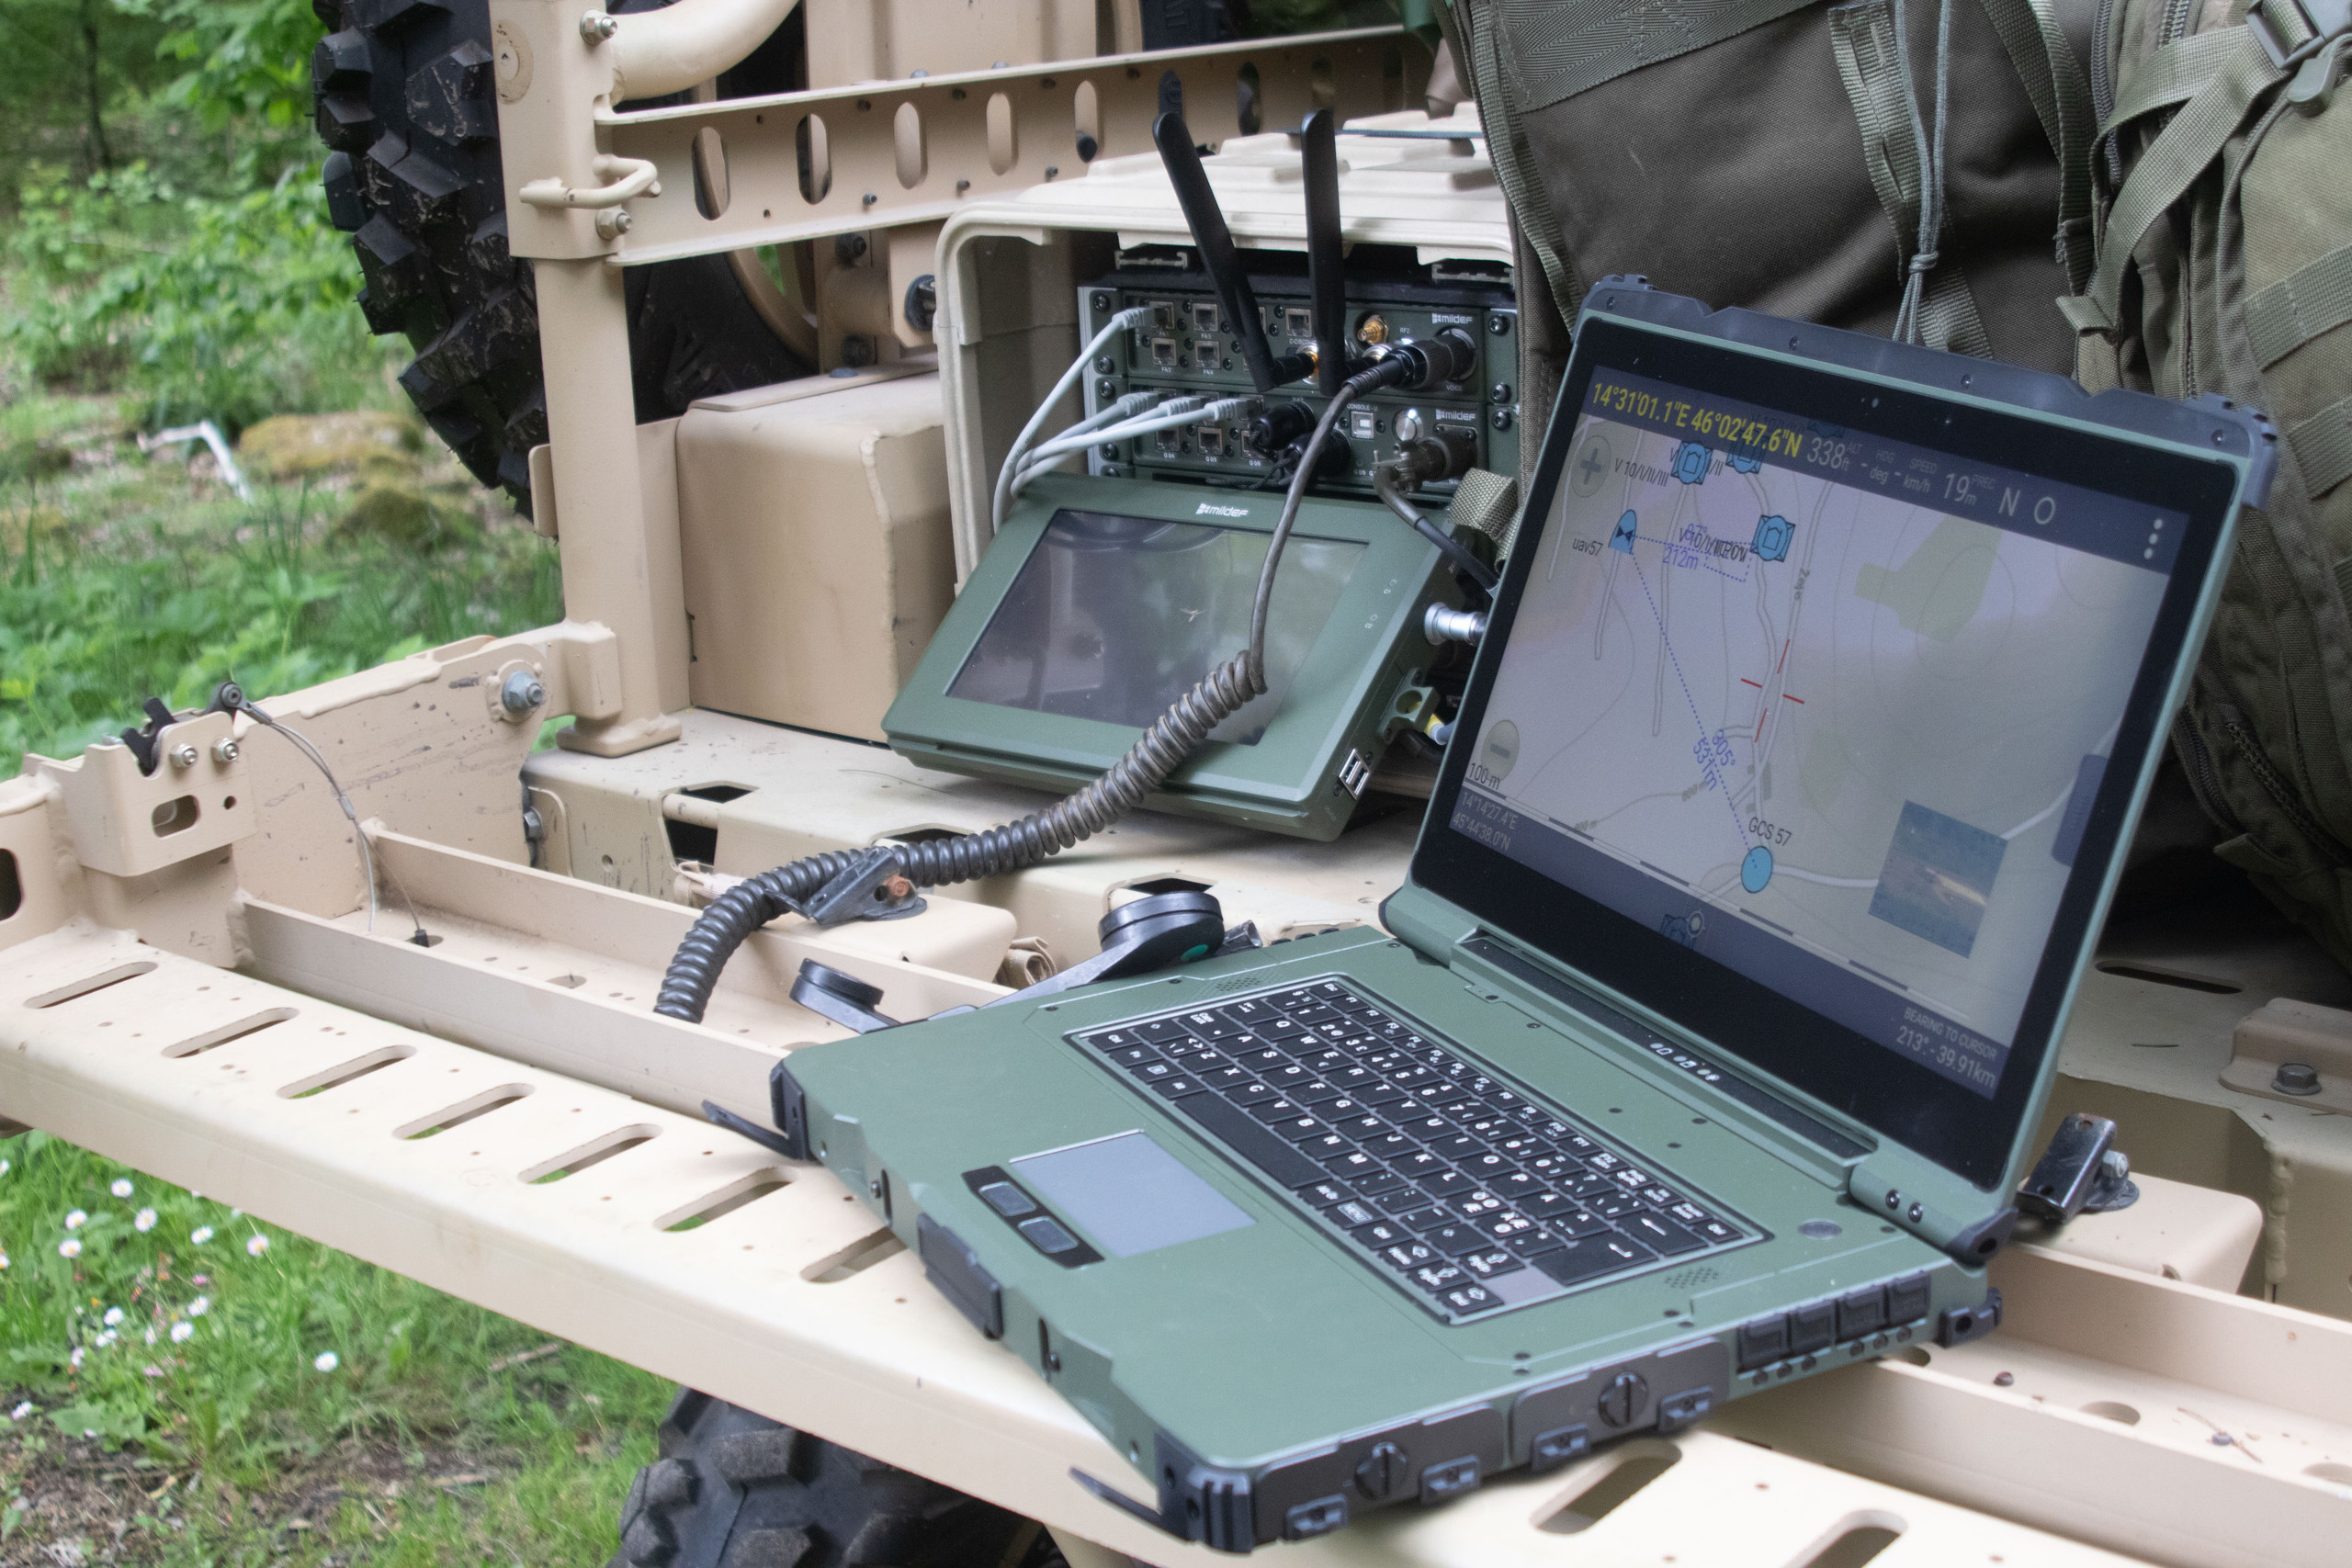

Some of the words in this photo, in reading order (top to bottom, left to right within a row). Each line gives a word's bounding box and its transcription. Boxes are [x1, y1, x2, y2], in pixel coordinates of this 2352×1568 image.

[1572, 536, 1604, 557] uav57
[1662, 547, 1699, 570] 212m
[1469, 761, 1489, 784] 100
[1747, 817, 1773, 840] GCS
[1770, 828, 1792, 847] 57
[1300, 1035, 1317, 1043] W
[1904, 1007, 1944, 1036] BEARING
[1945, 1025, 1959, 1043] TO
[1958, 1034, 1998, 1062] CURSOR
[1200, 1052, 1216, 1060] Z
[1224, 1067, 1240, 1076] X
[1284, 1066, 1301, 1074] D
[1349, 1067, 1364, 1076] R
[1336, 1100, 1351, 1108] G
[1297, 1118, 1315, 1126] B
[1362, 1117, 1378, 1126] H
[1427, 1118, 1443, 1126] U
[1323, 1135, 1341, 1145] N
[1348, 1154, 1367, 1164] M
[1415, 1154, 1432, 1163] K
[1442, 1172, 1456, 1181] L
[1510, 1173, 1529, 1181] P
